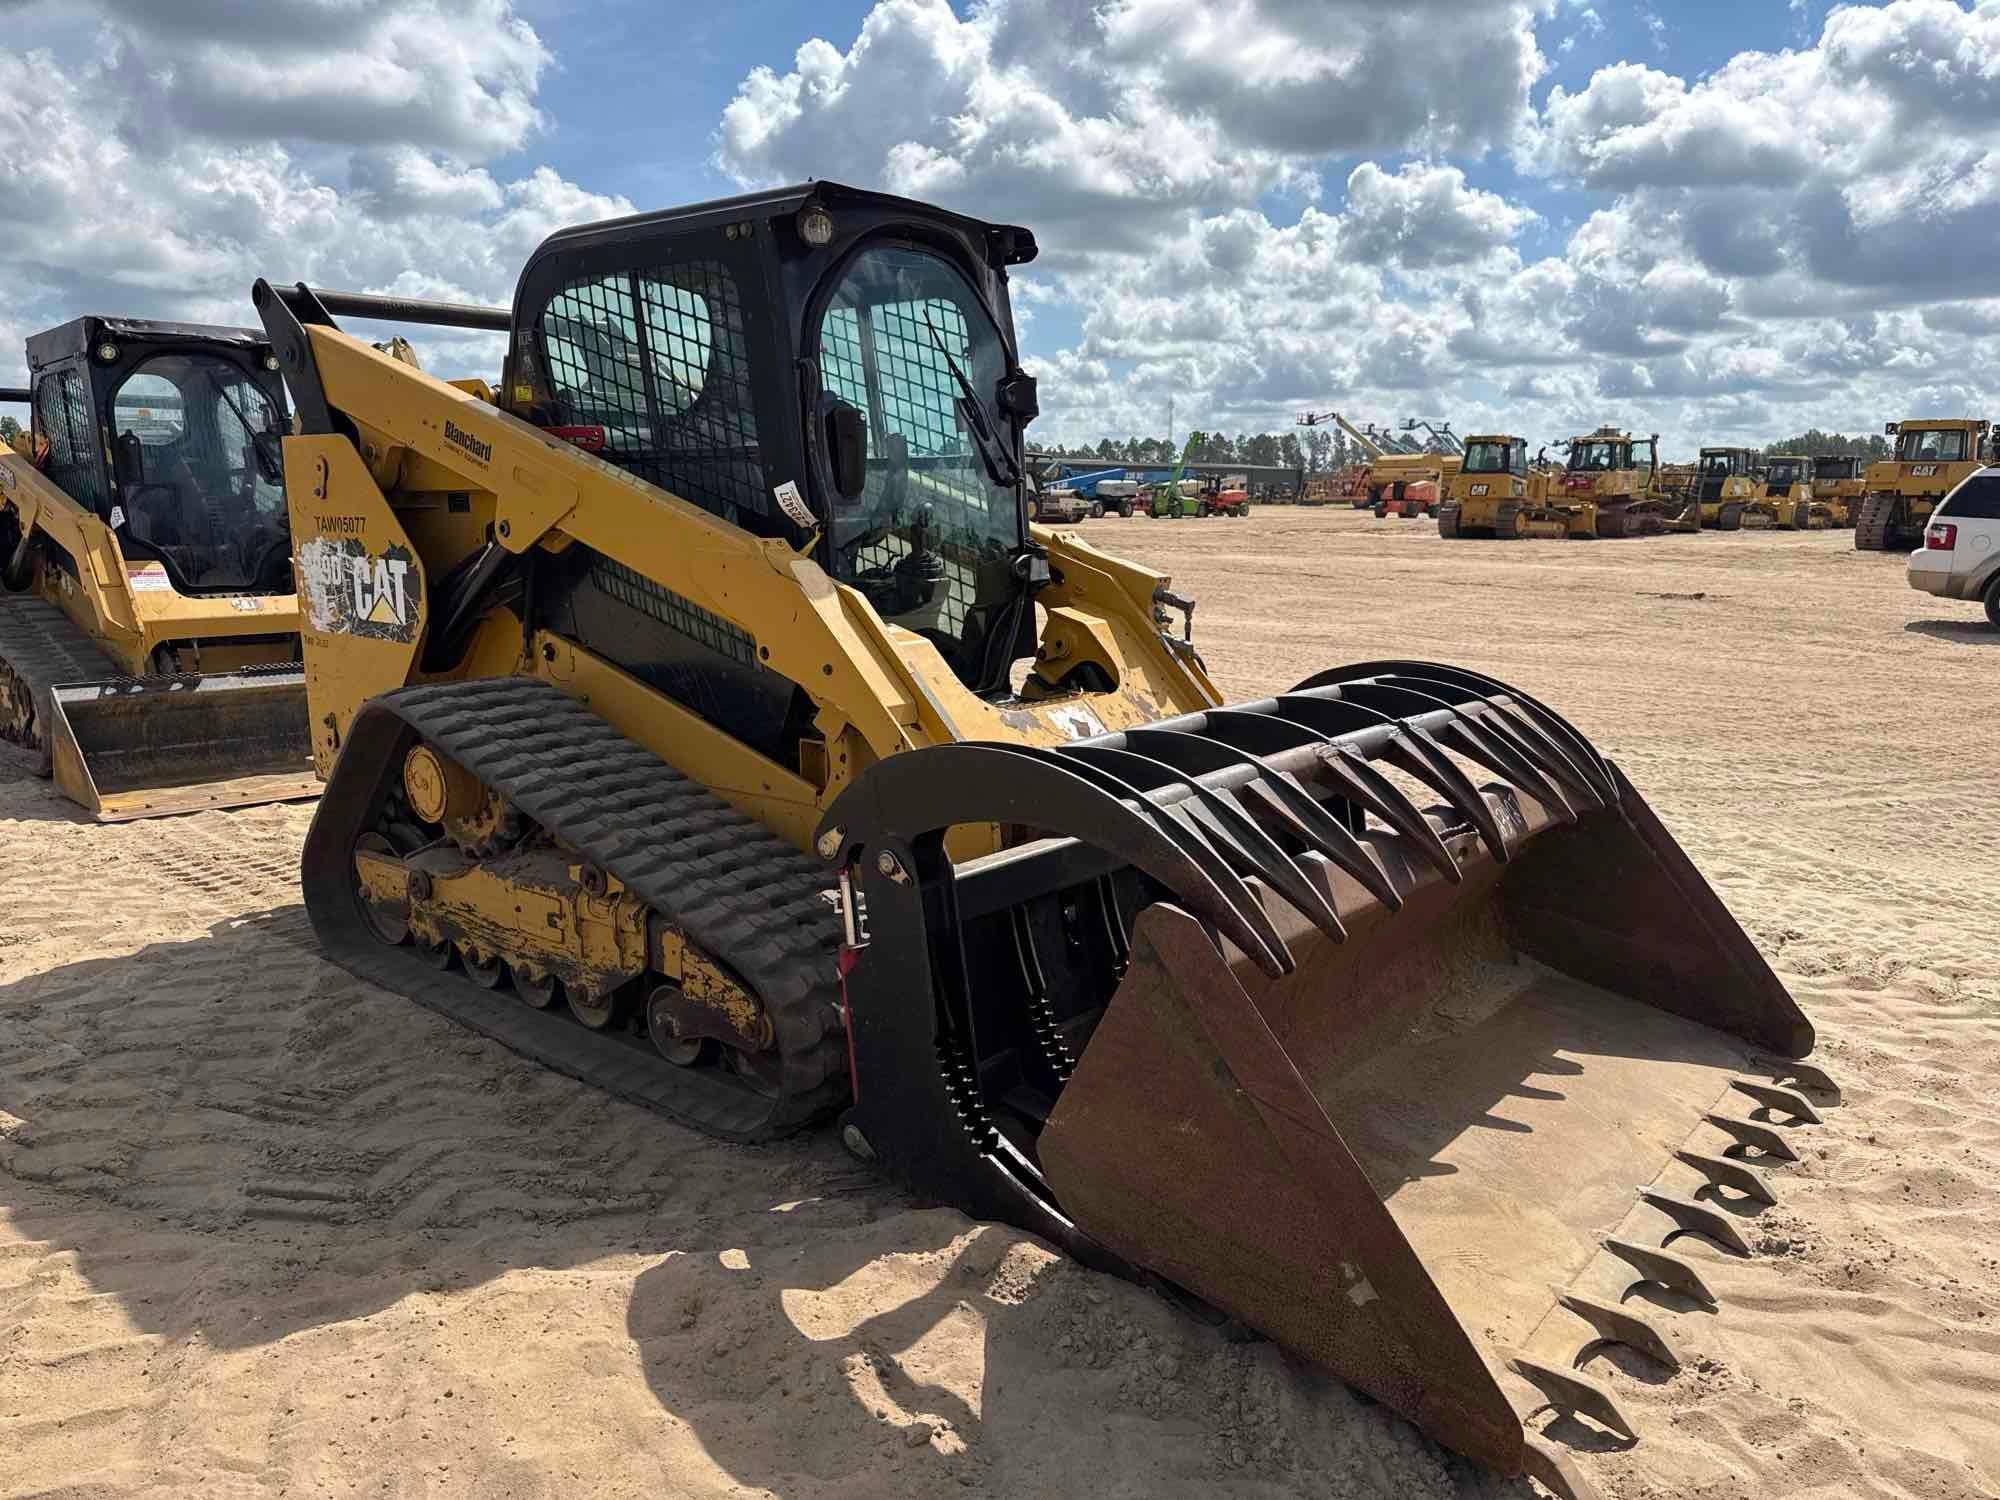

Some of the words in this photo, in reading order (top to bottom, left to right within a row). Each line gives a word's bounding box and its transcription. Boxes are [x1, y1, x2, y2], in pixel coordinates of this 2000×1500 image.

[1911, 465, 1936, 476] CAT
[1472, 485, 1488, 496] CAT
[353, 556, 408, 626] CAT
